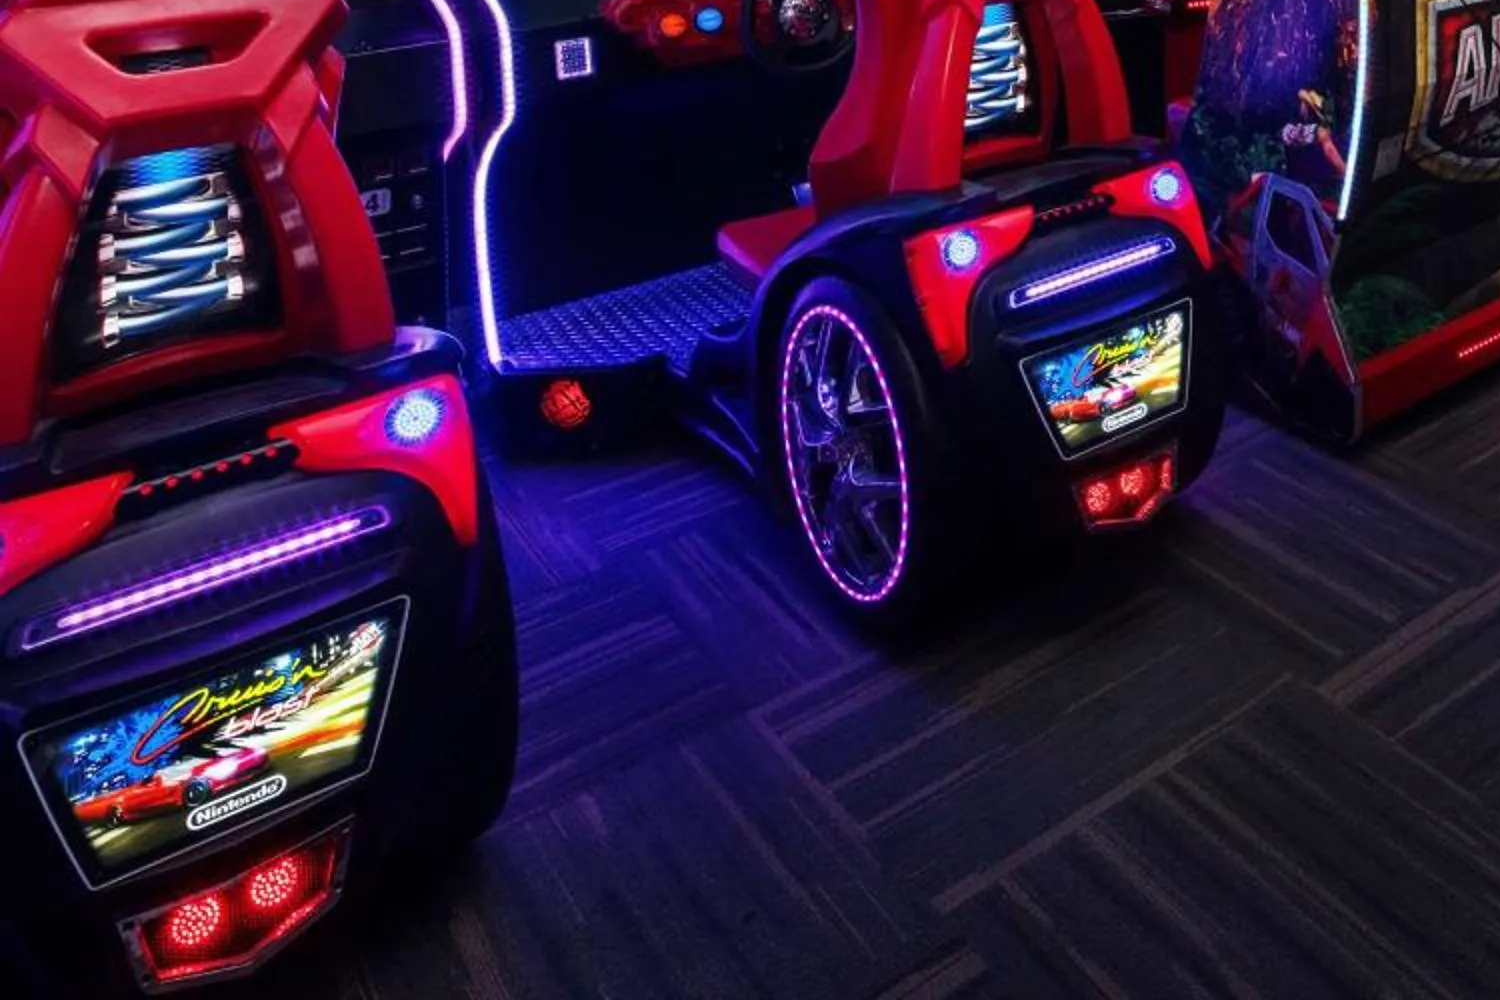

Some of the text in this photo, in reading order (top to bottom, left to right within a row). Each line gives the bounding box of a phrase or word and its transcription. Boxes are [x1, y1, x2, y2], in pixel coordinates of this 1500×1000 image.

[131, 657, 328, 765] Cruis'n
[213, 684, 320, 741] blast
[194, 778, 281, 825] Nintendo
